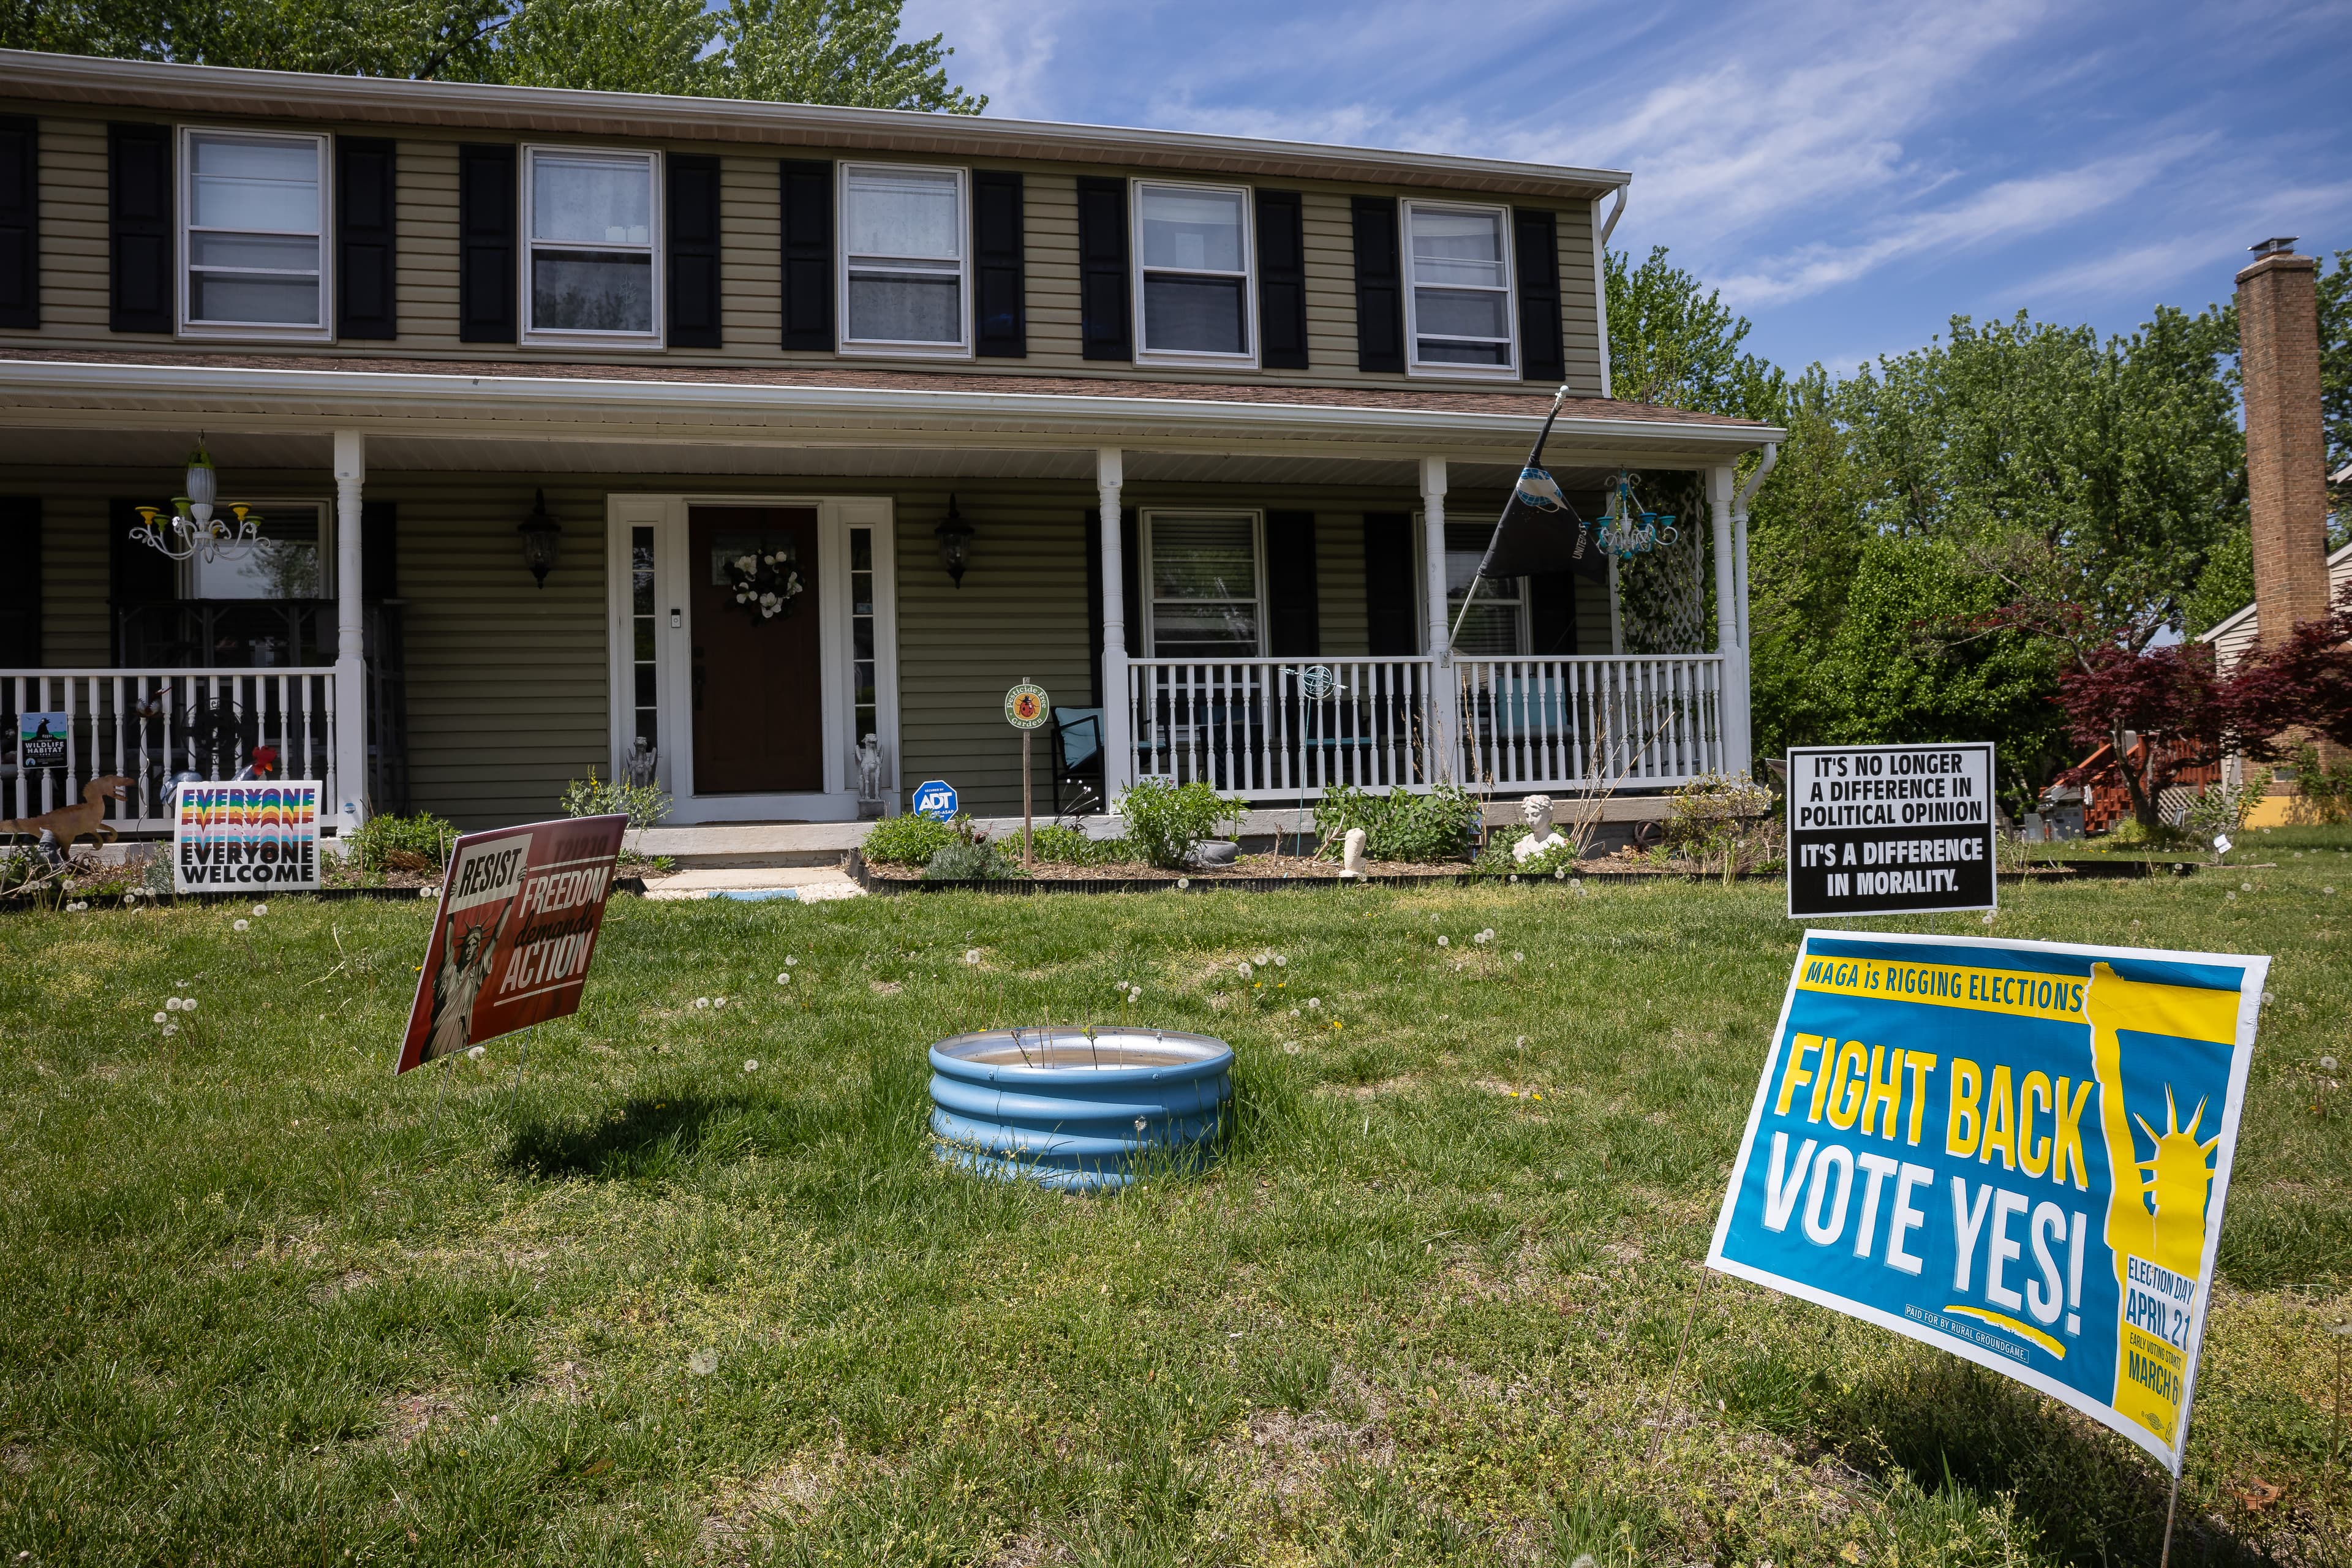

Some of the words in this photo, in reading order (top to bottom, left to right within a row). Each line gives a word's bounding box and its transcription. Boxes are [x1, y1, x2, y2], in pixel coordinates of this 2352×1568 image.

[1572, 534, 1586, 559] UNITED
[1011, 718, 1042, 727] Garden
[1815, 756, 1848, 777] IT'S
[1855, 755, 1882, 776] NO
[1890, 753, 1962, 775] LONGER
[919, 792, 952, 811] ADT
[1810, 782, 1823, 802] A
[1830, 778, 1945, 801] DIFFERENCE
[1952, 777, 1972, 797] IN
[1801, 804, 1896, 827] POLITICAL
[1902, 801, 1982, 824] OPINION
[181, 864, 314, 883] WELCOME
[458, 848, 523, 899] RESIST
[1801, 843, 1836, 867] IT'S
[1842, 843, 1857, 865] A
[1863, 838, 1983, 864] DIFFERENCE
[519, 866, 610, 919] FREEDOM
[1827, 873, 1849, 896] IN
[1857, 869, 1959, 895] MORALITY.
[514, 899, 594, 949] demands
[499, 929, 594, 995] ACTION
[1805, 961, 1858, 987] MAGA
[1864, 962, 1880, 990] is
[1885, 968, 1962, 998] RIGGING
[1969, 974, 2083, 1012] ELECTIONS
[1774, 1032, 1937, 1147] FIGHT
[1945, 1057, 2094, 1192] BACK
[1761, 1131, 1934, 1276] VOTE
[1950, 1175, 2087, 1338] YES!
[2128, 1257, 2174, 1296] ELECTION
[2174, 1276, 2195, 1305] DAY
[1906, 1306, 1922, 1319] PAID
[1924, 1313, 1938, 1325] FOR
[1940, 1318, 1949, 1329] BY
[1951, 1322, 1973, 1338] RURAL
[1976, 1332, 2026, 1360] GROUNDGAME.
[2126, 1287, 2168, 1341] APRIL
[2171, 1309, 2191, 1351] 21
[2130, 1332, 2146, 1350] EARLY
[2147, 1340, 2165, 1360] VOTING
[2165, 1350, 2182, 1370] STARTS
[2128, 1350, 2171, 1400] MARCH
[2172, 1374, 2179, 1406] 6
